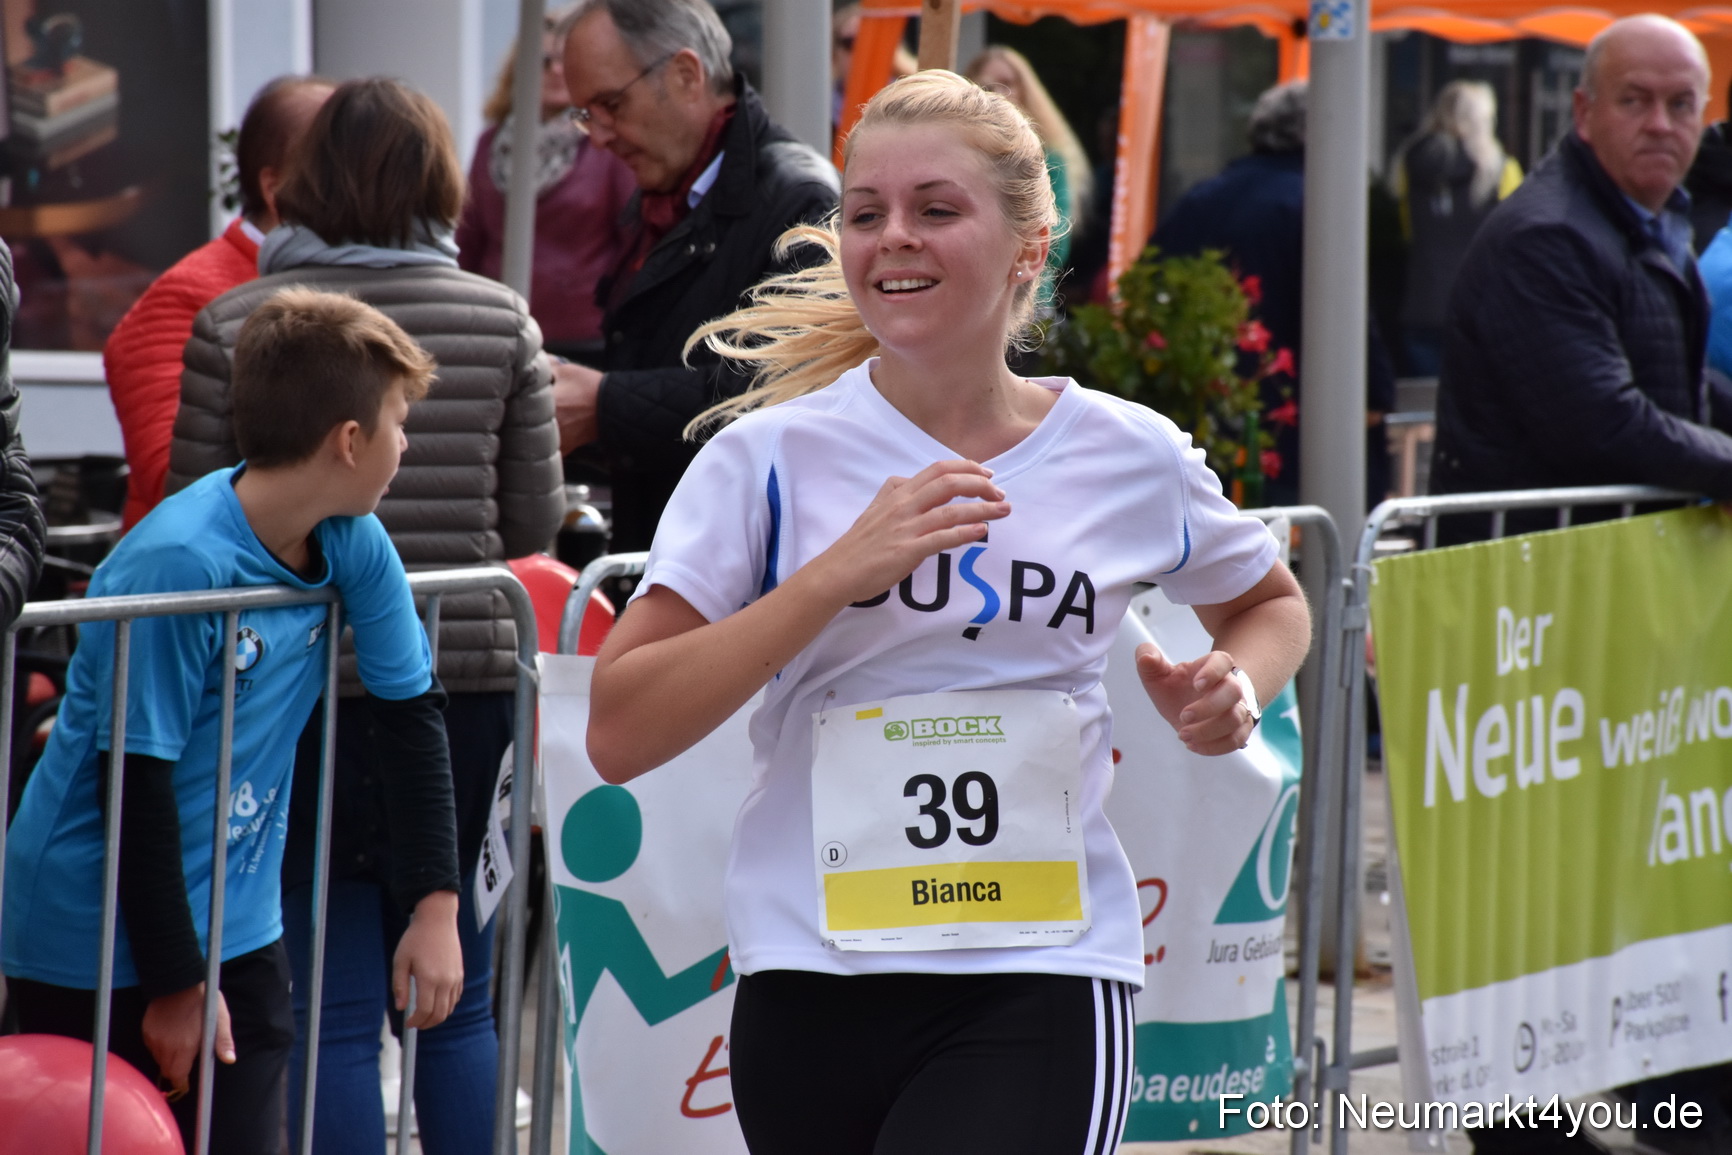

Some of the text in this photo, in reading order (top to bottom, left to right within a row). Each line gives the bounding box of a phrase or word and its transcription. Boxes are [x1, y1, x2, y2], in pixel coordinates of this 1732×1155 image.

[847, 522, 1096, 641] USPA
[1496, 606, 1553, 676] Der
[911, 716, 1004, 739] BOCK
[912, 738, 941, 748] inspired
[953, 737, 973, 745] smart
[975, 736, 1006, 745] concepts
[1424, 683, 1585, 808] Neue
[1600, 686, 1684, 769] weiß
[903, 770, 999, 850] 39
[829, 848, 839, 862] D
[911, 878, 1002, 906] Bianca
[1206, 939, 1239, 964] Jura
